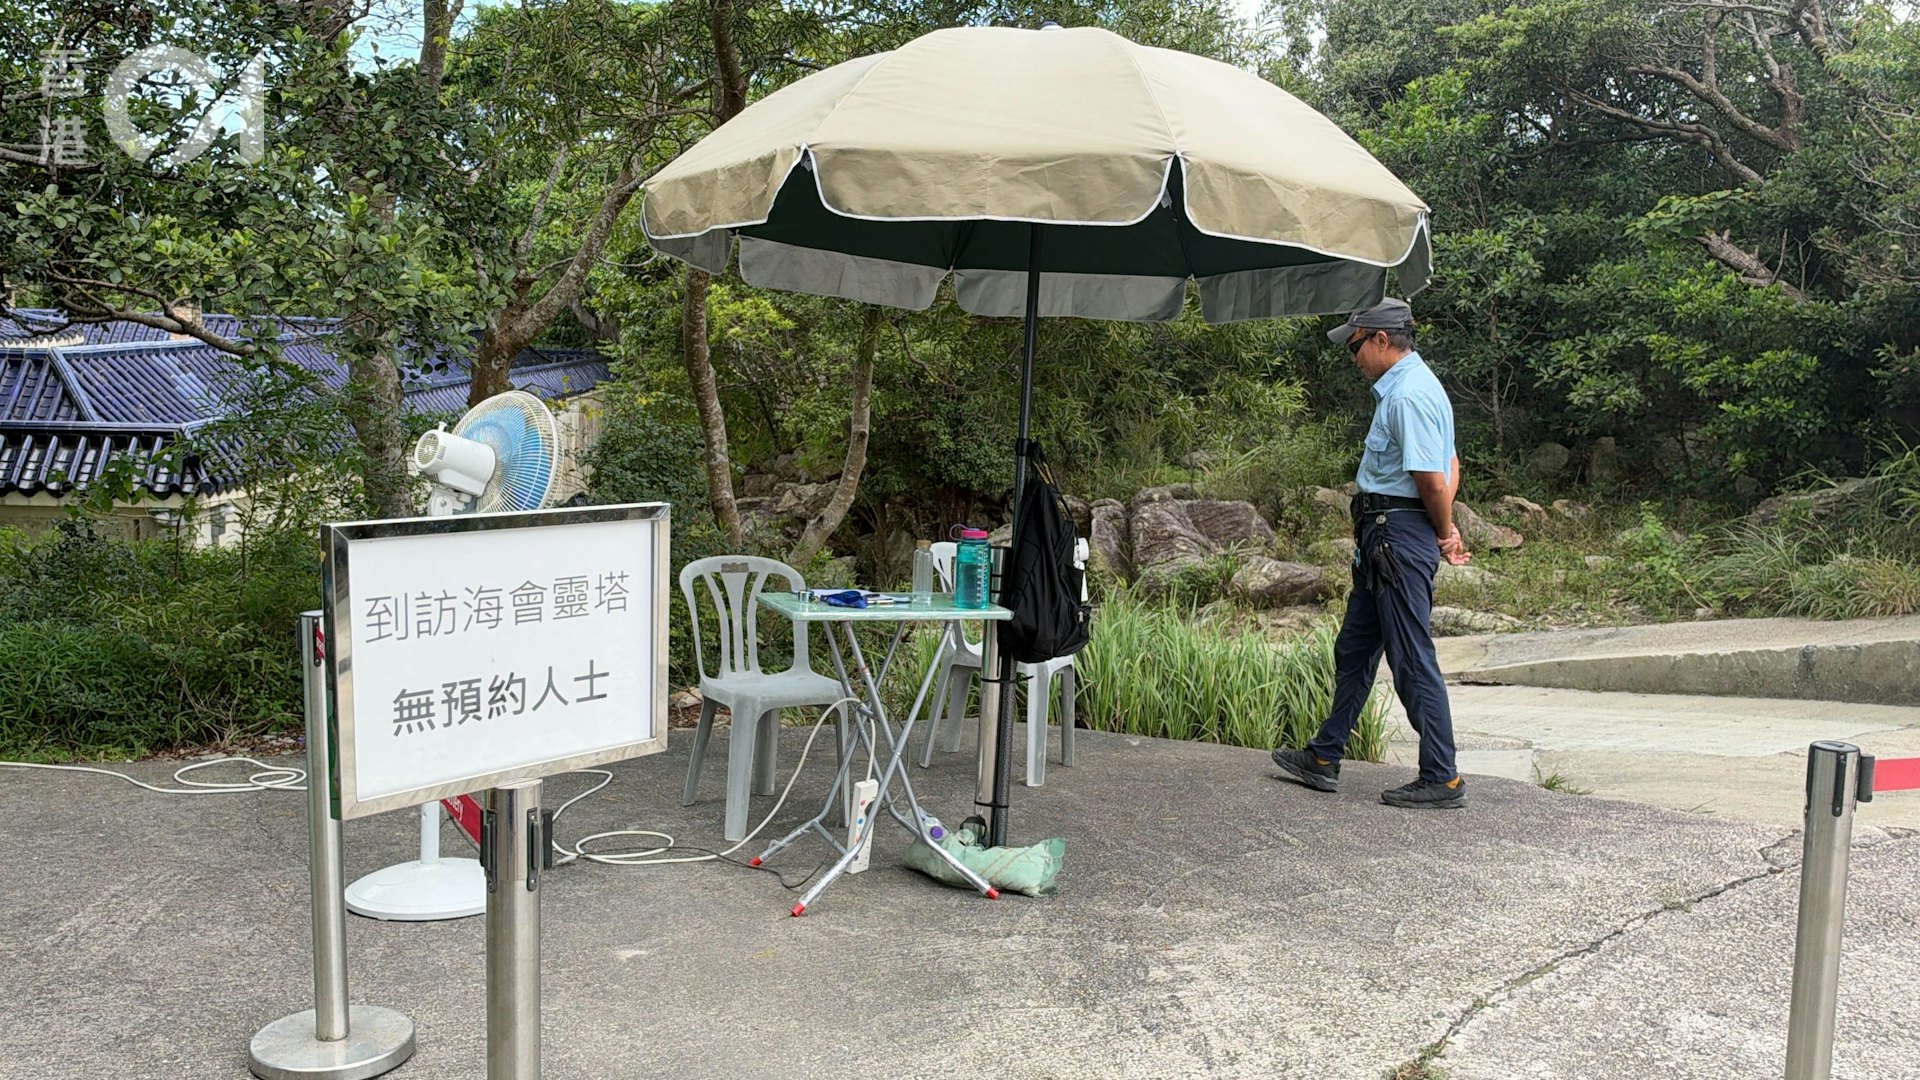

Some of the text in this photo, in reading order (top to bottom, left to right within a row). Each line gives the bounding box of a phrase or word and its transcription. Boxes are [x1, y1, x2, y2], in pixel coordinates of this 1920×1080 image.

[364, 570, 631, 644] 到訪海會靈塔
[392, 659, 610, 737] 無預約人士
